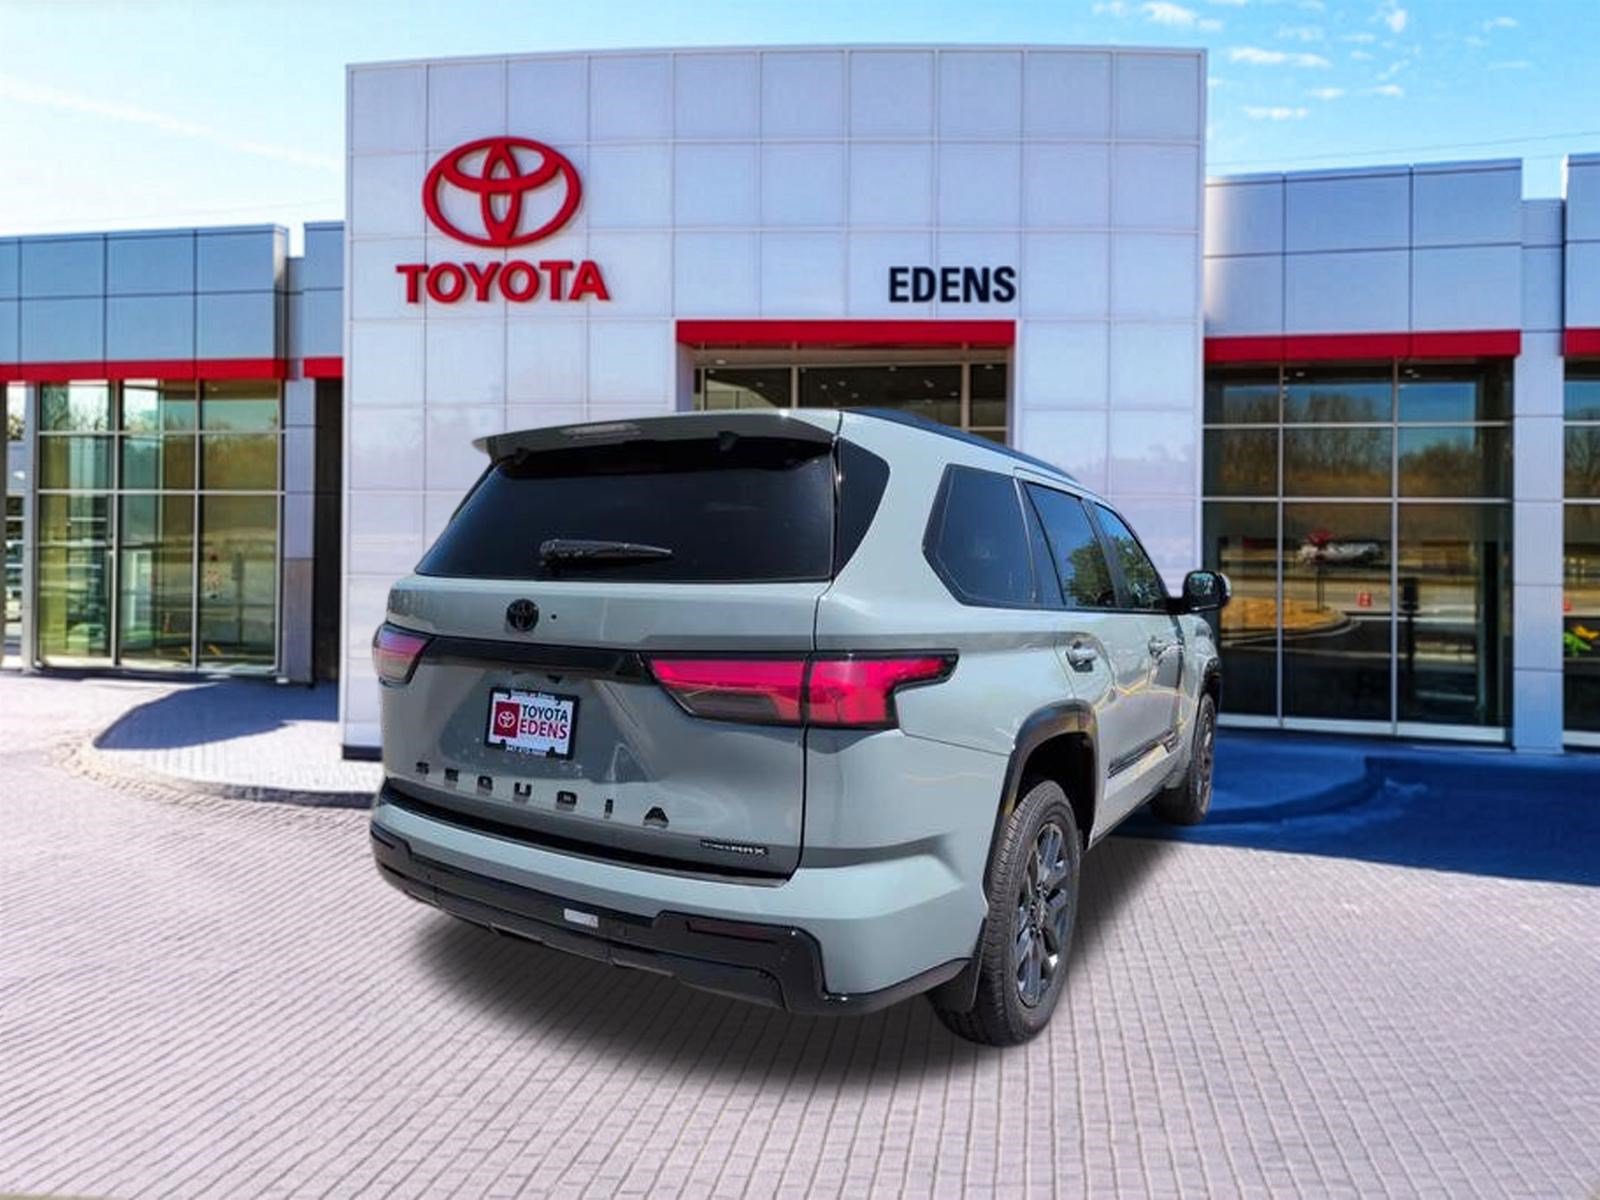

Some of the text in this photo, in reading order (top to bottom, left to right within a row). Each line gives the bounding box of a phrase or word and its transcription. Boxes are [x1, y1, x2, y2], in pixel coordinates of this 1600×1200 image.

[396, 259, 611, 304] TOYOTA
[889, 266, 1017, 303] EDENS
[522, 704, 569, 723] TOYOTA
[519, 719, 568, 740] EDENS
